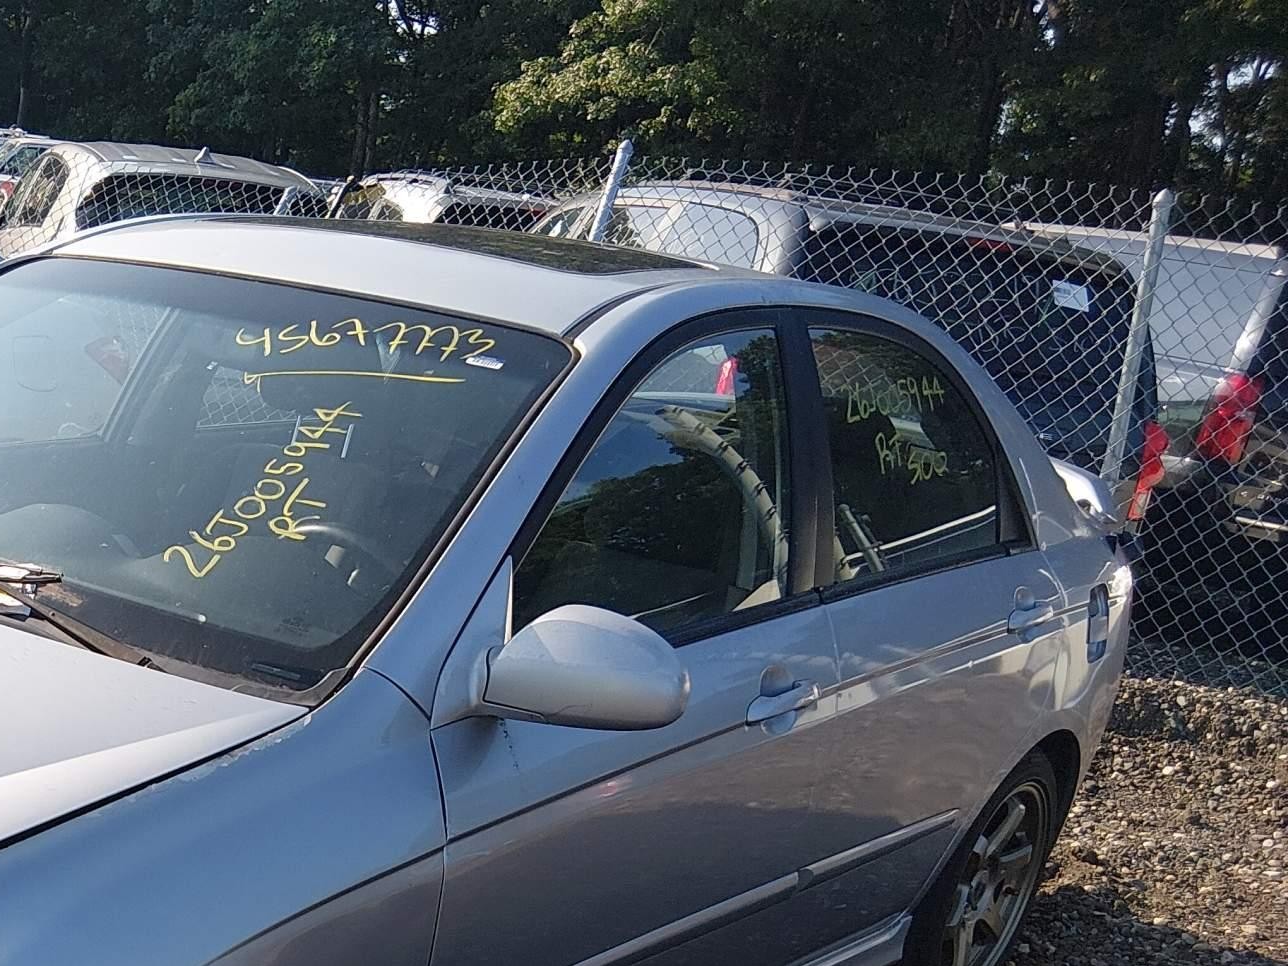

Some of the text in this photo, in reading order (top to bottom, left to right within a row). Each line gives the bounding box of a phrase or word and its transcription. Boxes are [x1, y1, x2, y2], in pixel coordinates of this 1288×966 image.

[235, 318, 497, 363] 45677773
[163, 401, 364, 578] 26J005944
[268, 477, 327, 541] RT
